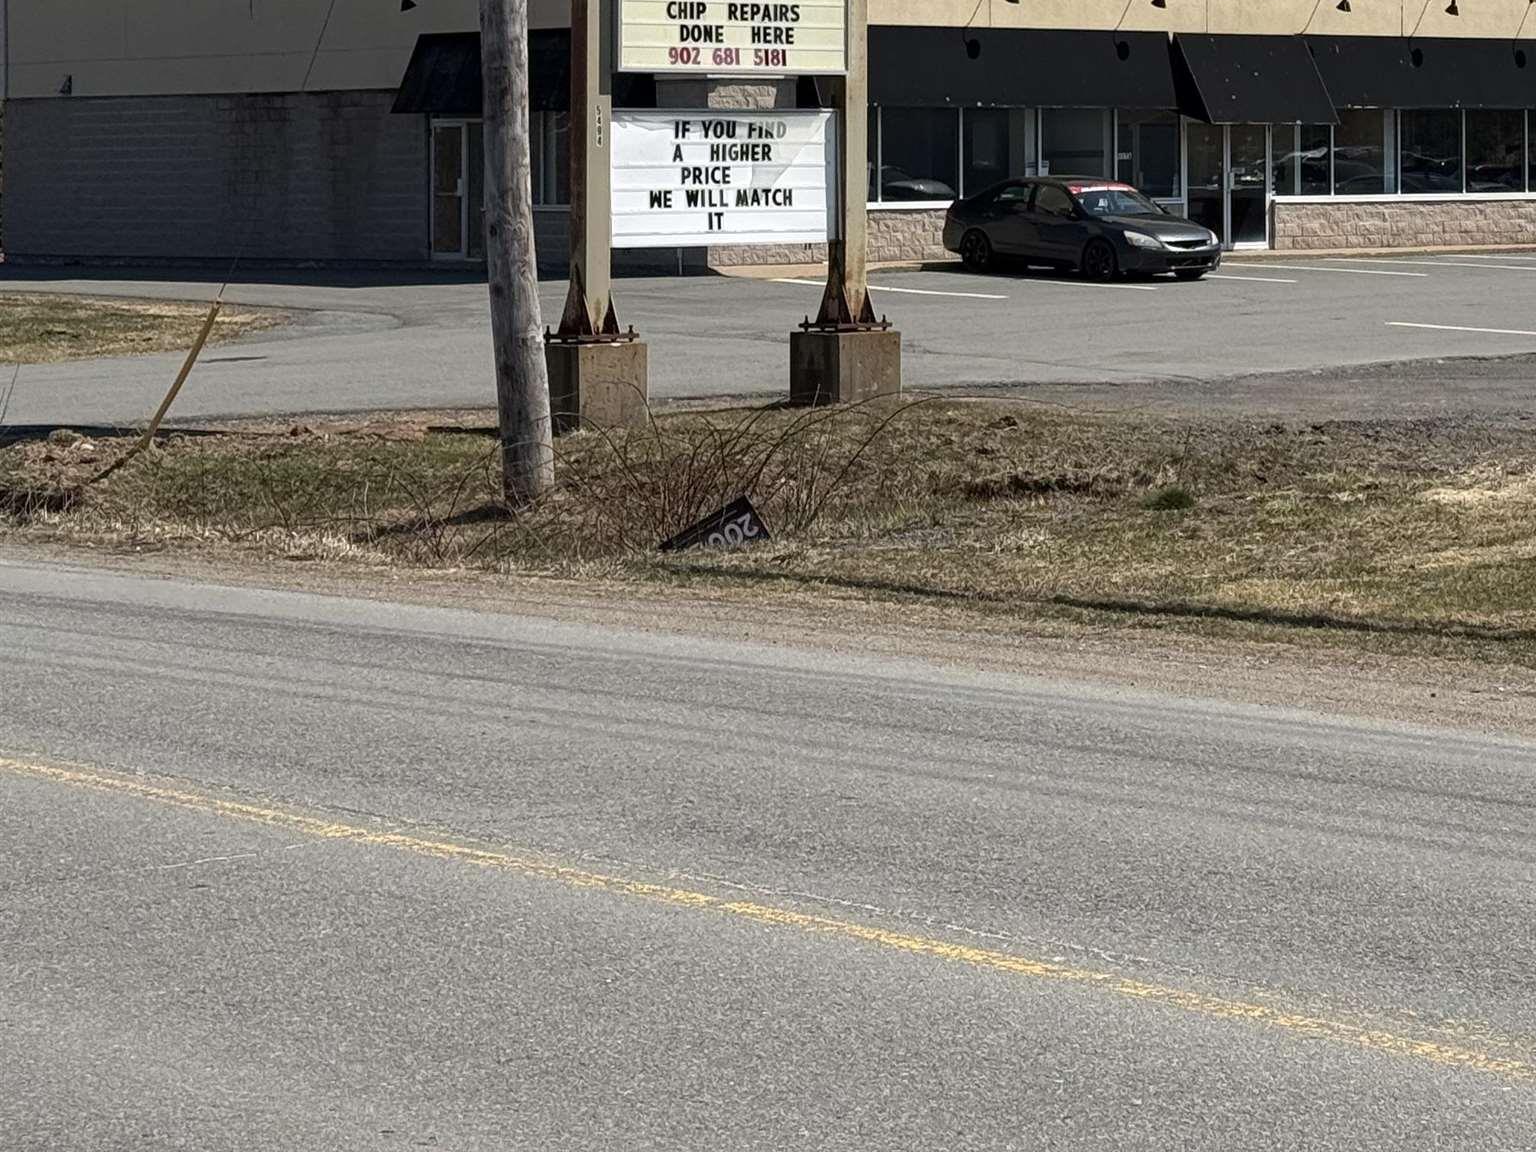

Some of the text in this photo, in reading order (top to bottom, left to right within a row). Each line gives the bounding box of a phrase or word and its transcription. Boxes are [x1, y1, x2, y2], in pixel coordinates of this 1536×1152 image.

[667, 1, 800, 22] CHIP REPAIRS
[680, 24, 794, 45] DONE HERE
[668, 47, 786, 67] 902 681 5181
[674, 120, 787, 139] IF YOU FIND
[672, 144, 772, 163] A HIGHER
[680, 166, 731, 185] PRICE
[649, 188, 793, 208] WE WILL MATCH
[708, 212, 724, 230] IT
